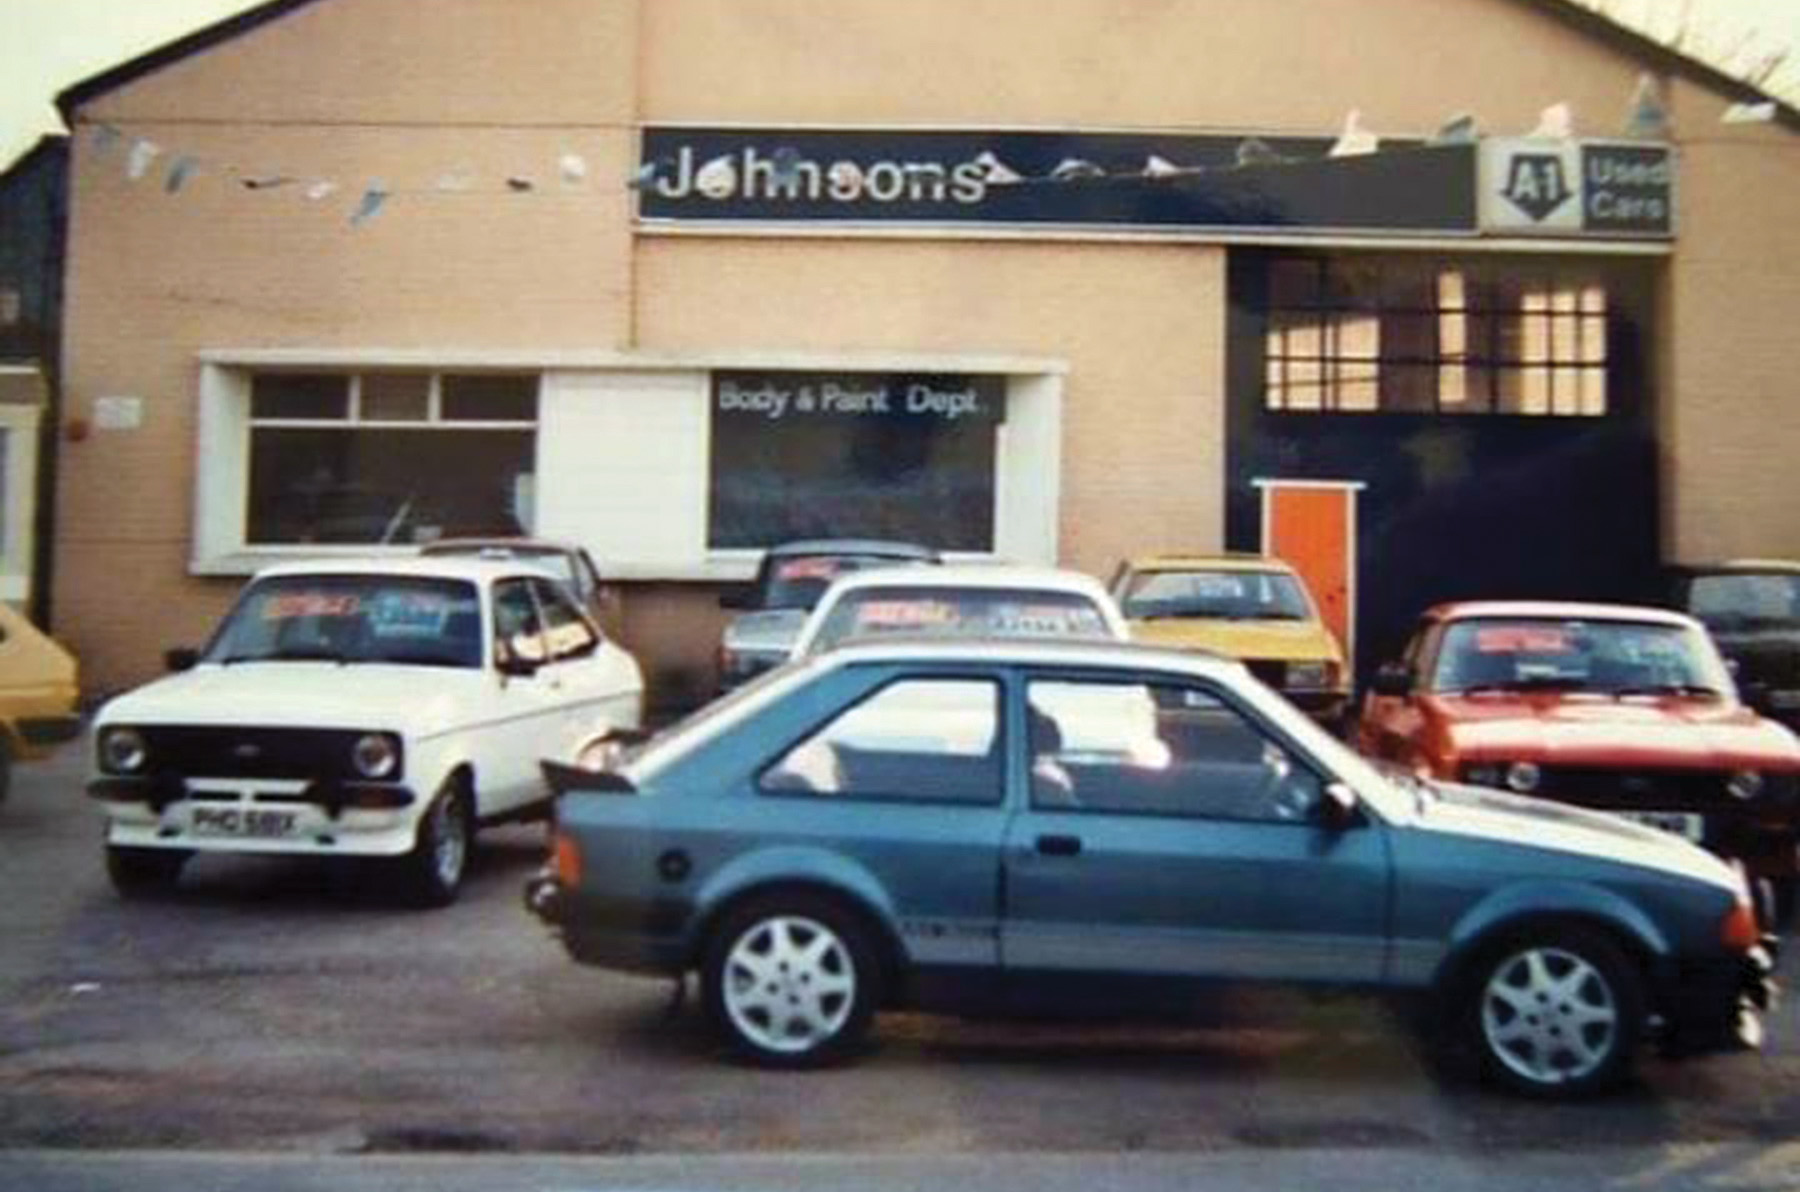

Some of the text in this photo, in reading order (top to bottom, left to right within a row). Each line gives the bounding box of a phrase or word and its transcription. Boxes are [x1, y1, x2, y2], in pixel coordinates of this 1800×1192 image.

[659, 146, 988, 201] Johnsons
[1591, 190, 1664, 218] Cars
[719, 382, 791, 417] Body
[796, 386, 815, 411] &
[820, 384, 889, 411] Paint
